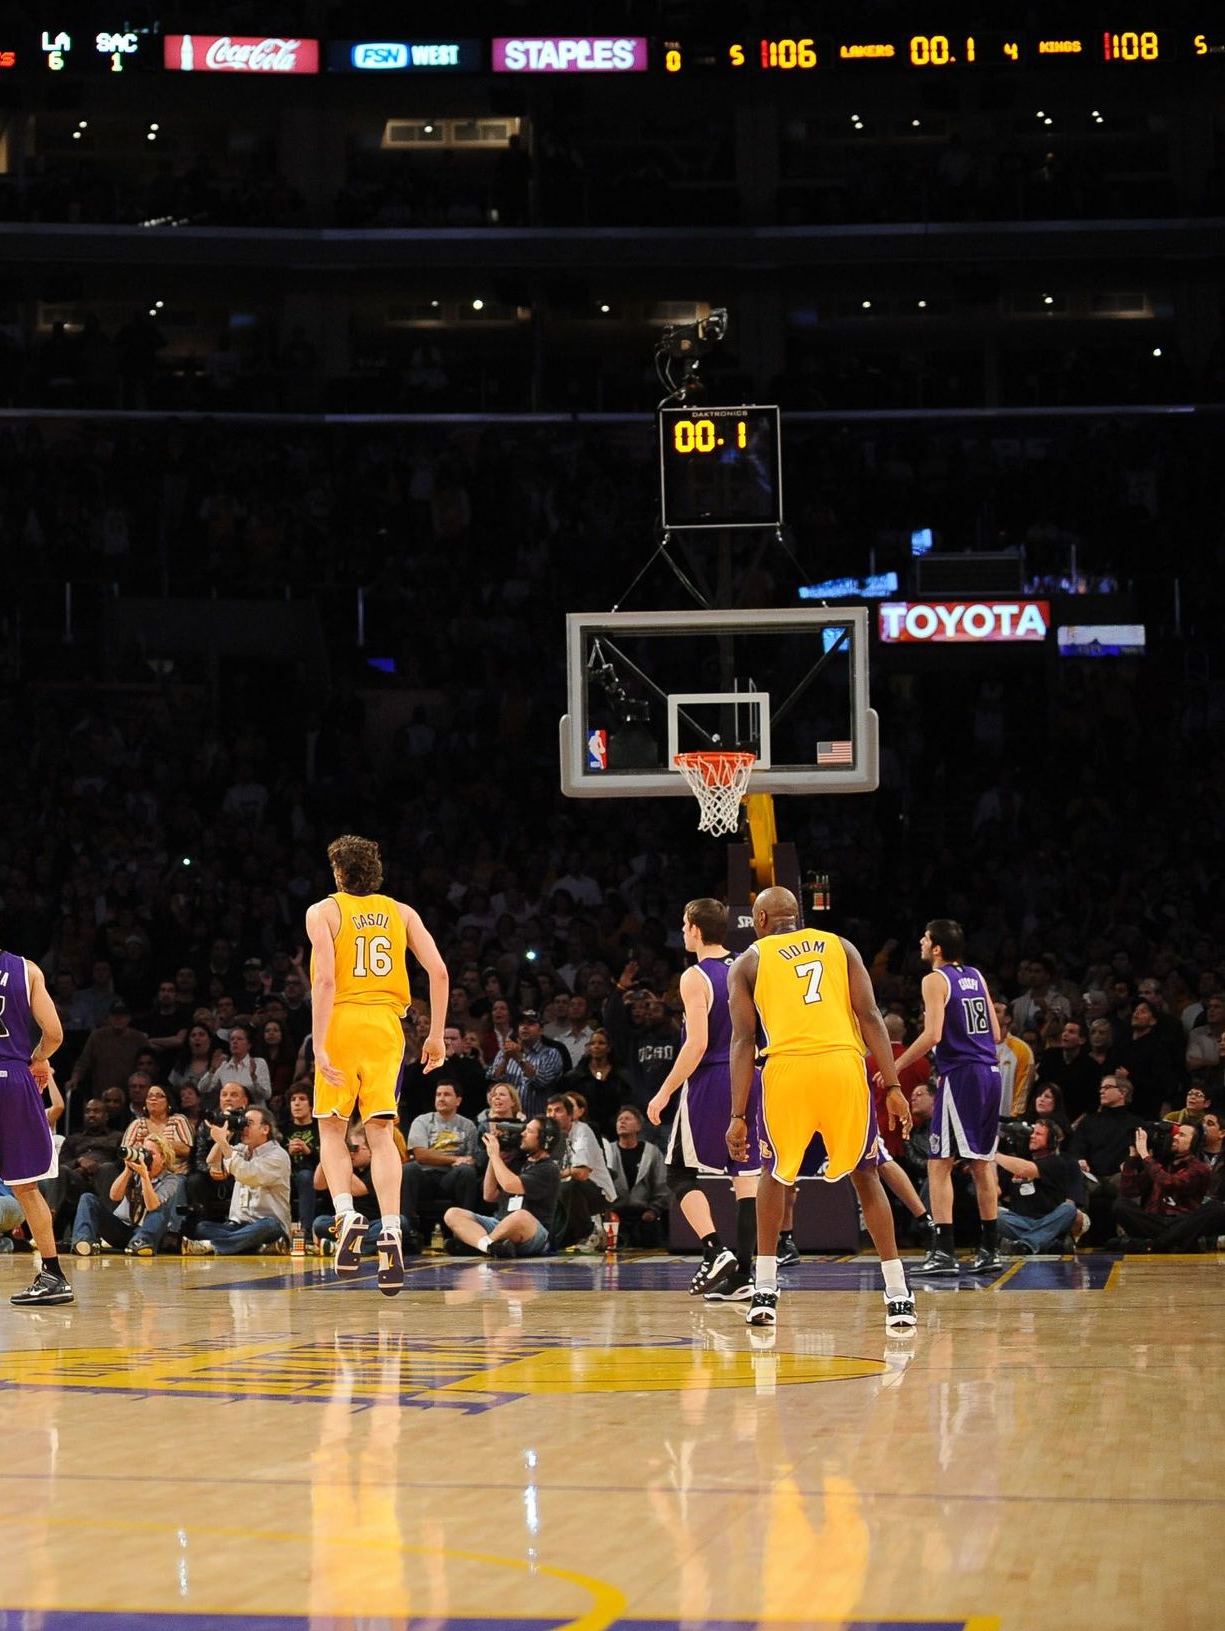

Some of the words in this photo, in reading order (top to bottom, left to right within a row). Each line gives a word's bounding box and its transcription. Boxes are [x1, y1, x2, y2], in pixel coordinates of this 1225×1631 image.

[42, 31, 71, 51] LA
[96, 32, 138, 53] SAC
[840, 45, 895, 58] LAKERS
[1039, 41, 1082, 53] KINGS
[1112, 32, 1159, 60] 108
[48, 51, 65, 71] 6
[111, 52, 123, 72] 1
[362, 48, 400, 63] FSN
[411, 45, 460, 66] WEST
[505, 40, 635, 70] STAPLES
[770, 39, 817, 69] 106
[691, 410, 749, 418] DAKTRONICS
[880, 604, 1047, 639] TOYOTA
[352, 913, 390, 930] GASOL
[353, 936, 393, 977] 16
[779, 940, 825, 960] ODOM
[794, 959, 824, 1005] 7
[961, 997, 990, 1035] 18
